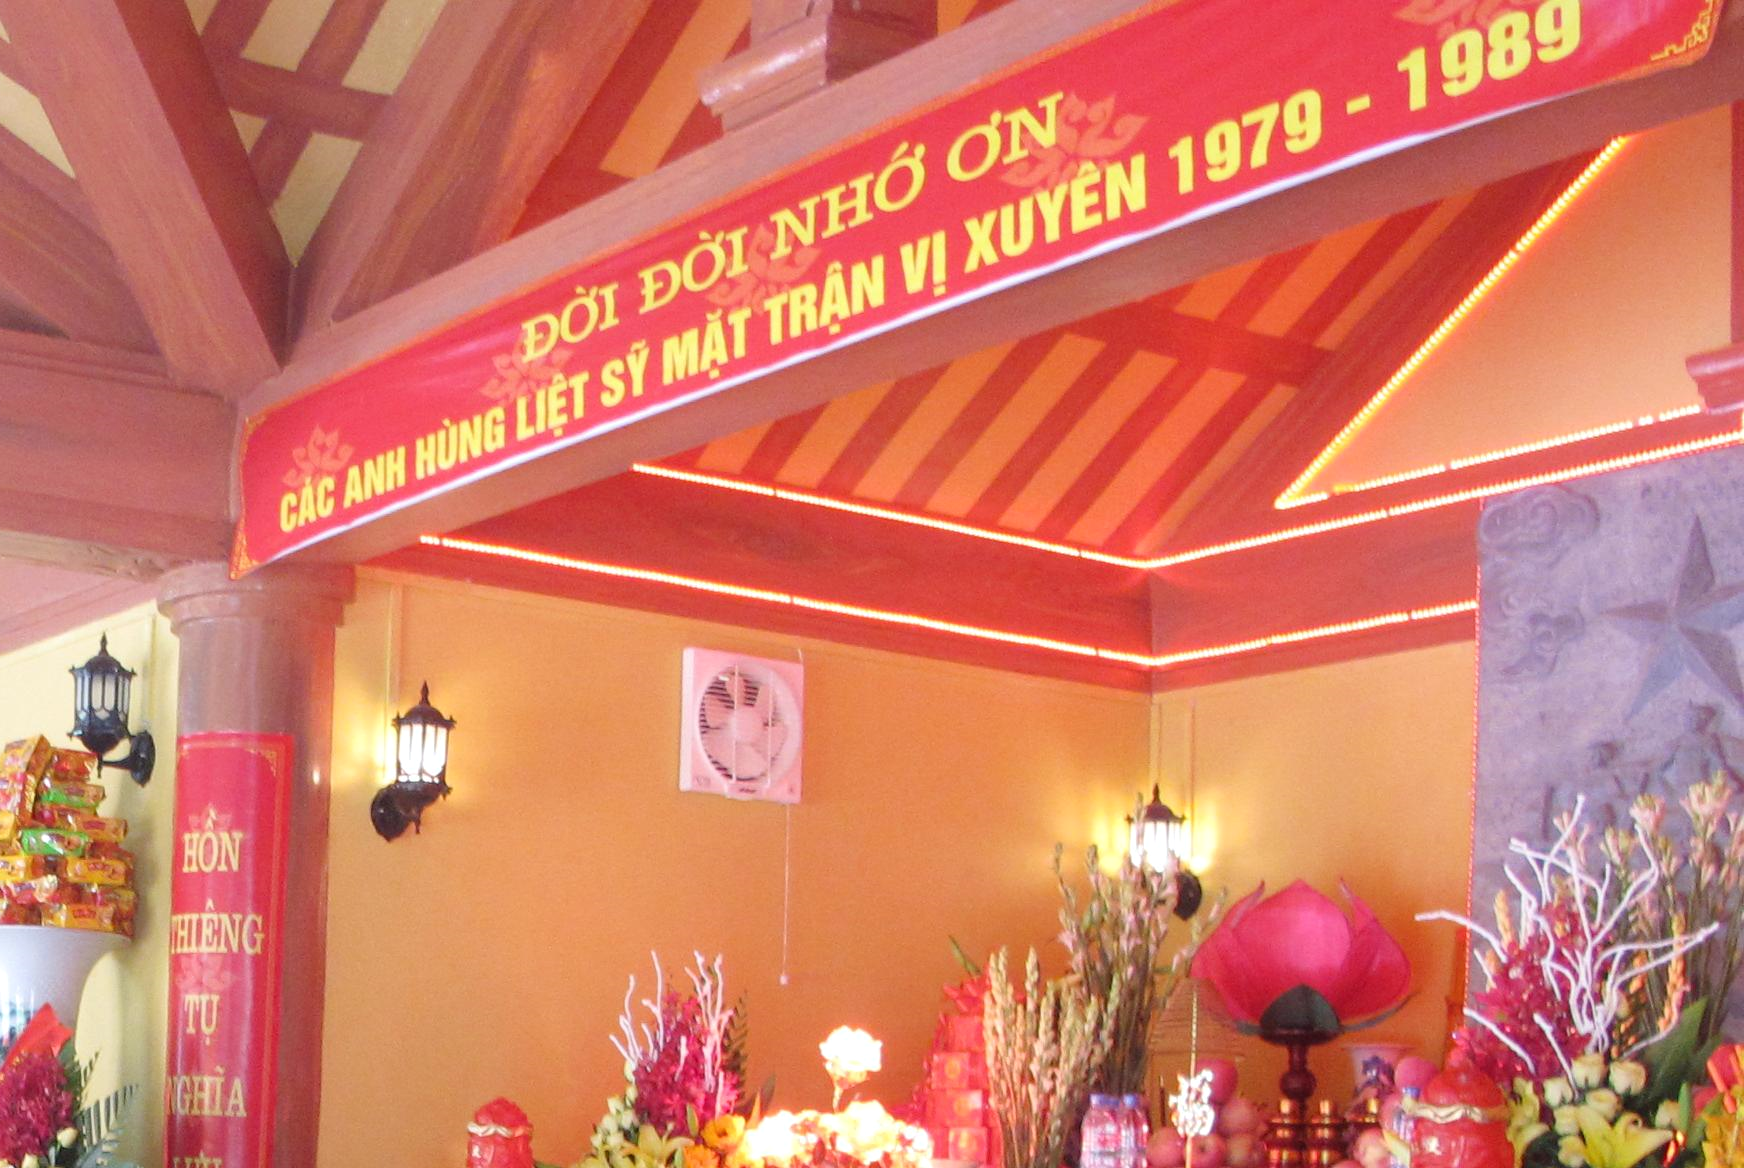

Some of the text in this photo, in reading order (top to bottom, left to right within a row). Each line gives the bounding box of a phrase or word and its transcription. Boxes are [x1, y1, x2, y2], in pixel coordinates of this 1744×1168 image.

[278, 475, 336, 533] CÁC
[343, 445, 406, 509] ANH
[414, 405, 506, 480] HÙNG
[515, 371, 590, 442] LIỆT
[599, 338, 651, 408] SỸ
[662, 306, 752, 386] MẶT
[764, 254, 885, 346] TRẬN
[899, 230, 947, 297] VỊ
[962, 153, 1148, 274] XUYÊN
[1167, 88, 1322, 195] 1979
[1396, 0, 1582, 112] 1989
[520, 91, 1064, 364] ĐỜI ĐỜI NHỚ ƠN
[182, 804, 243, 873] HỒN
[184, 993, 220, 1046] TỤ
